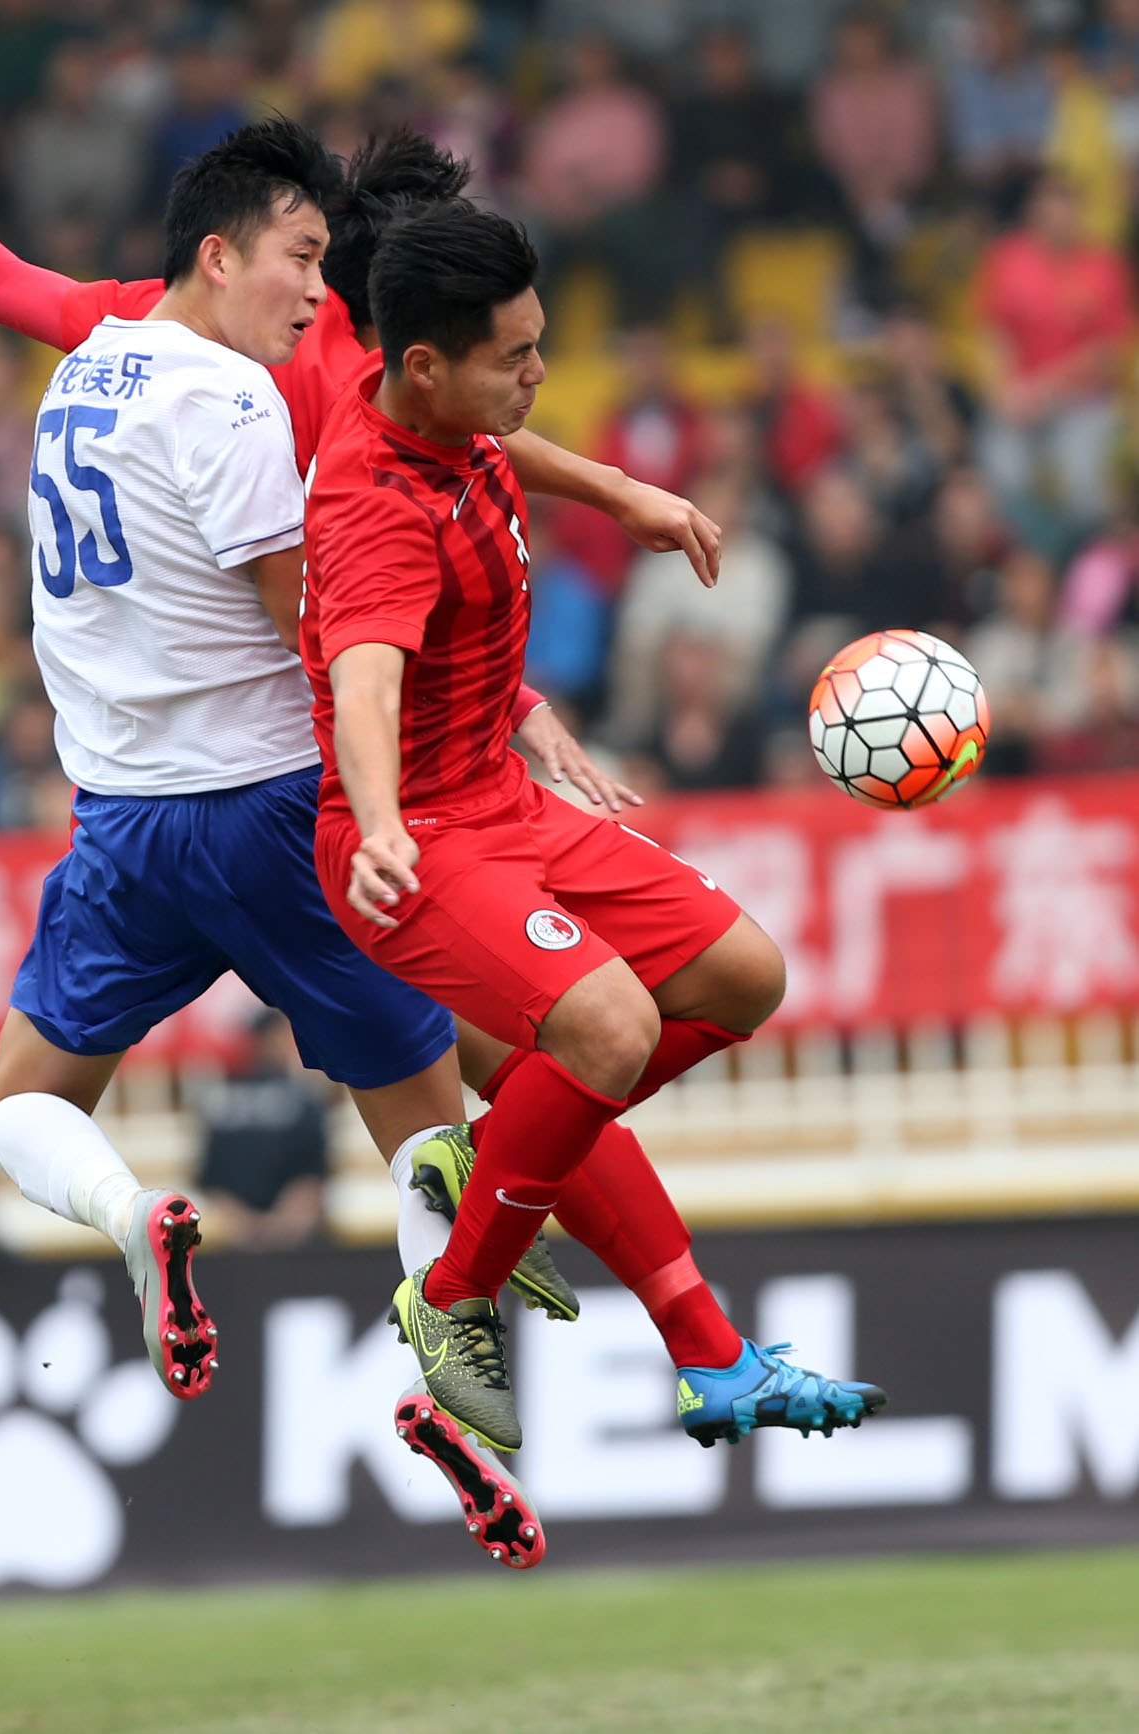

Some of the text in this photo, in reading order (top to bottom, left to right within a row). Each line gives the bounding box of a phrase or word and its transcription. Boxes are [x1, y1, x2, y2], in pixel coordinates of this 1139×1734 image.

[43, 351, 153, 400] 花娱乐
[231, 408, 271, 430] KELME
[31, 404, 133, 599] 55
